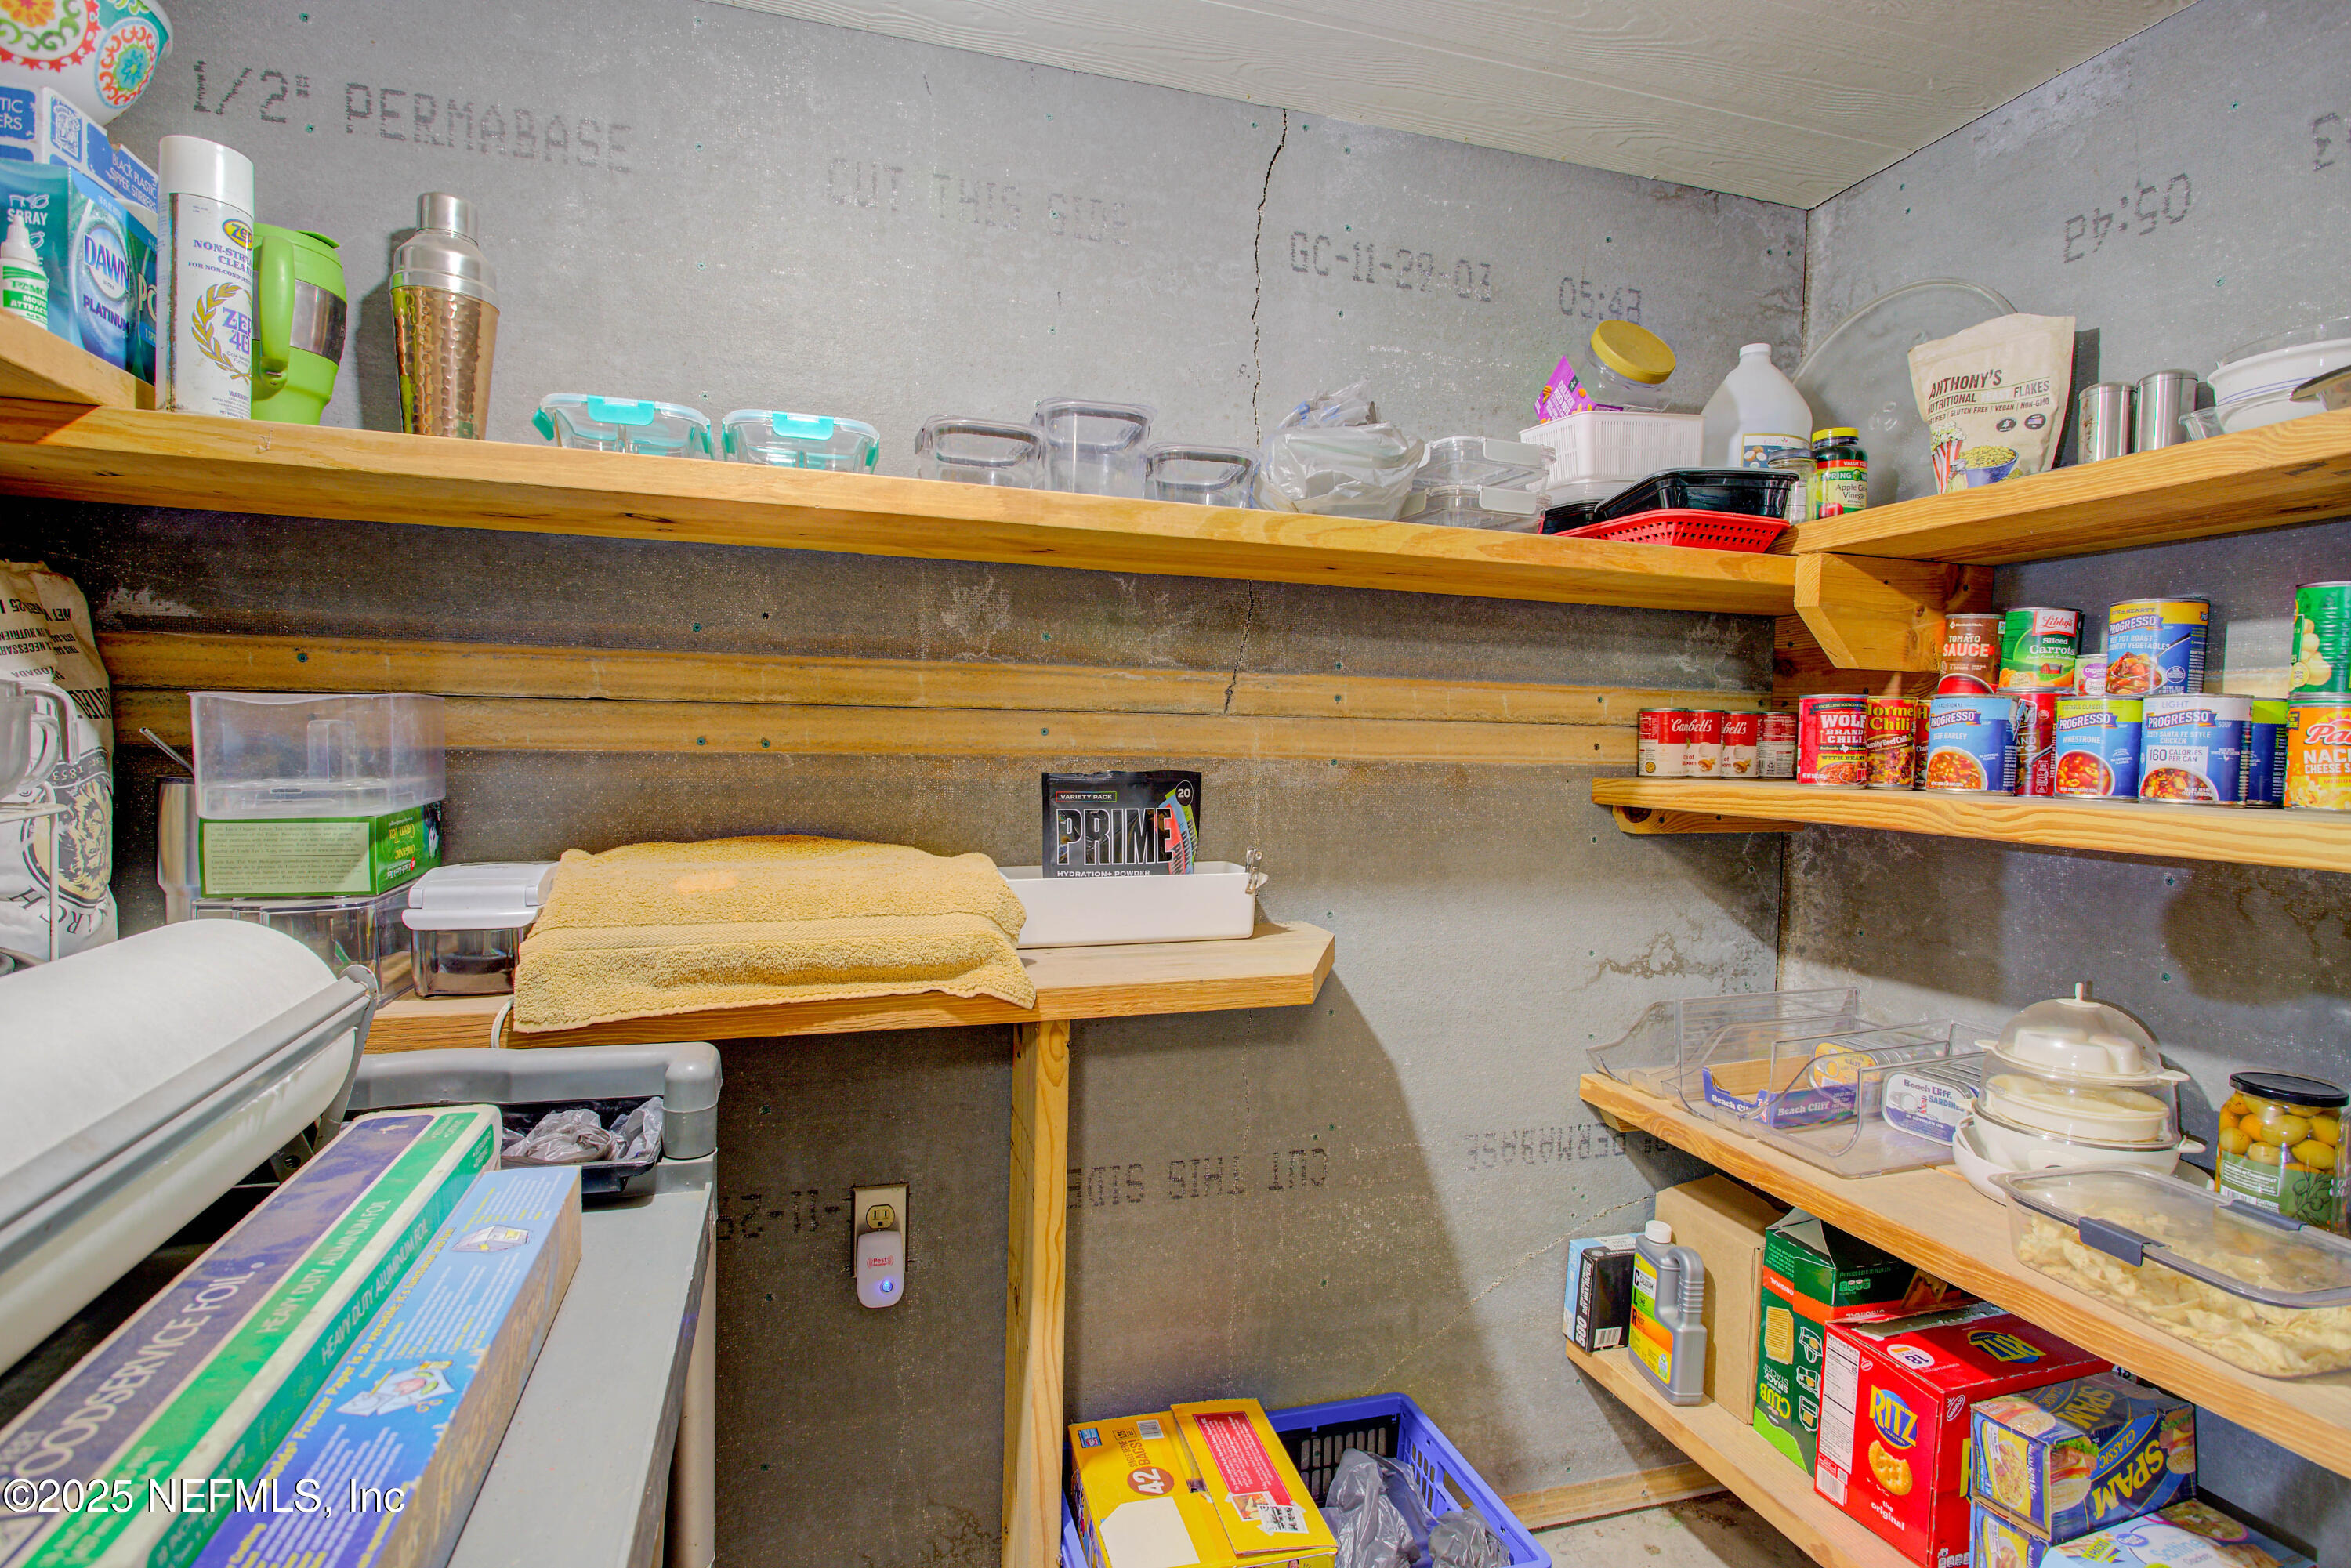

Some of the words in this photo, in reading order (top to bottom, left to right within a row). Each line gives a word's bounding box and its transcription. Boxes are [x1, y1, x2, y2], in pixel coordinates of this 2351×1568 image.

[193, 60, 310, 124] 1/2"
[346, 81, 632, 173] PERMABASE
[110, 167, 131, 193] SIPPER
[112, 154, 133, 179] BLACK
[133, 170, 157, 199] PLASTIC
[828, 158, 904, 212] CUT
[933, 173, 1020, 230] THIS
[83, 234, 131, 292] DAWN
[83, 294, 130, 332] PLATINUM
[1929, 369, 2003, 400] ANTHONY'S
[2013, 380, 2050, 398] FLAKES
[1950, 407, 1972, 418] GLUTEN
[2020, 397, 2049, 410] NON-GMO
[1821, 472, 1852, 480] SPRING
[53, 608, 71, 621] NET
[2041, 614, 2074, 628] Libby's
[2109, 614, 2157, 634] PROGRESSO
[1949, 634, 1982, 643] TOMATO
[1943, 643, 1991, 657] SAUCE
[2028, 644, 2076, 656] Carrots
[2161, 701, 2190, 709] LIGHT
[1820, 714, 1867, 730] WOLF
[1869, 716, 1911, 731] Chili
[1931, 710, 1976, 728] PROGRESSO
[2059, 713, 2110, 730] PROGRESSO
[2148, 711, 2209, 729] PROGRESSO
[1827, 735, 1862, 744] CHILI
[1882, 737, 1896, 746] Beef
[1896, 735, 1908, 744] Chili
[2150, 748, 2167, 762] 160
[52, 763, 85, 783] 1853
[2304, 764, 2343, 775] CHEESE
[1177, 788, 1191, 798] 20
[1056, 808, 1176, 866] PRIME
[1057, 870, 1113, 878] HYDRATION+
[1114, 869, 1150, 878] POWDER
[1904, 1077, 1931, 1093] Beach
[1712, 1094, 1736, 1110] Beach
[1777, 1103, 1807, 1117] Beach
[1808, 1100, 1831, 1113] Cliff
[1463, 1122, 1628, 1172] PERMABASE
[1168, 1155, 1246, 1202] THIS
[1267, 1147, 1329, 1191] CUT
[1066, 1163, 1145, 1209] SIDE
[257, 1289, 300, 1334] HEAVY
[292, 1267, 331, 1299] DUTY
[317, 1219, 372, 1266] ALUMINUM
[360, 1199, 392, 1222] FOIL
[1634, 1269, 1640, 1287] C
[1770, 1276, 1795, 1296] ORIGINAL
[182, 1269, 256, 1315] FOIL
[321, 1315, 354, 1367] HEAVY
[351, 1284, 375, 1324] DUTY
[375, 1241, 418, 1295] ALUMINUM
[411, 1218, 429, 1251] FOIL
[1633, 1291, 1638, 1306] L
[1576, 1314, 1588, 1348] 500
[1584, 1262, 1592, 1288] PAPERS
[1632, 1308, 1637, 1327] R
[293, 1396, 332, 1439] Freezer
[324, 1365, 357, 1396] Paper
[403, 1252, 437, 1291] functional
[1968, 1334, 2048, 1363] RITZ
[1904, 1353, 1929, 1365] 18
[1763, 1363, 1789, 1385] STACKS
[1763, 1371, 1789, 1394] SNACK
[1759, 1382, 1791, 1419] CLUB
[2037, 1385, 2065, 1408] CLASSIC
[1869, 1384, 1919, 1447] RITZ
[2055, 1385, 2116, 1430] SPAM
[1884, 1429, 1906, 1447] CRACKERS
[2097, 1427, 2136, 1469] CLASSIC
[1128, 1438, 1152, 1467] BAGS!
[1132, 1468, 1165, 1495] 42
[2025, 1465, 2037, 1494] SPAM
[2090, 1438, 2164, 1520] SPAM
[1882, 1499, 1894, 1513] the
[1870, 1501, 1905, 1532] original
[2092, 1540, 2110, 1556] PACKS
